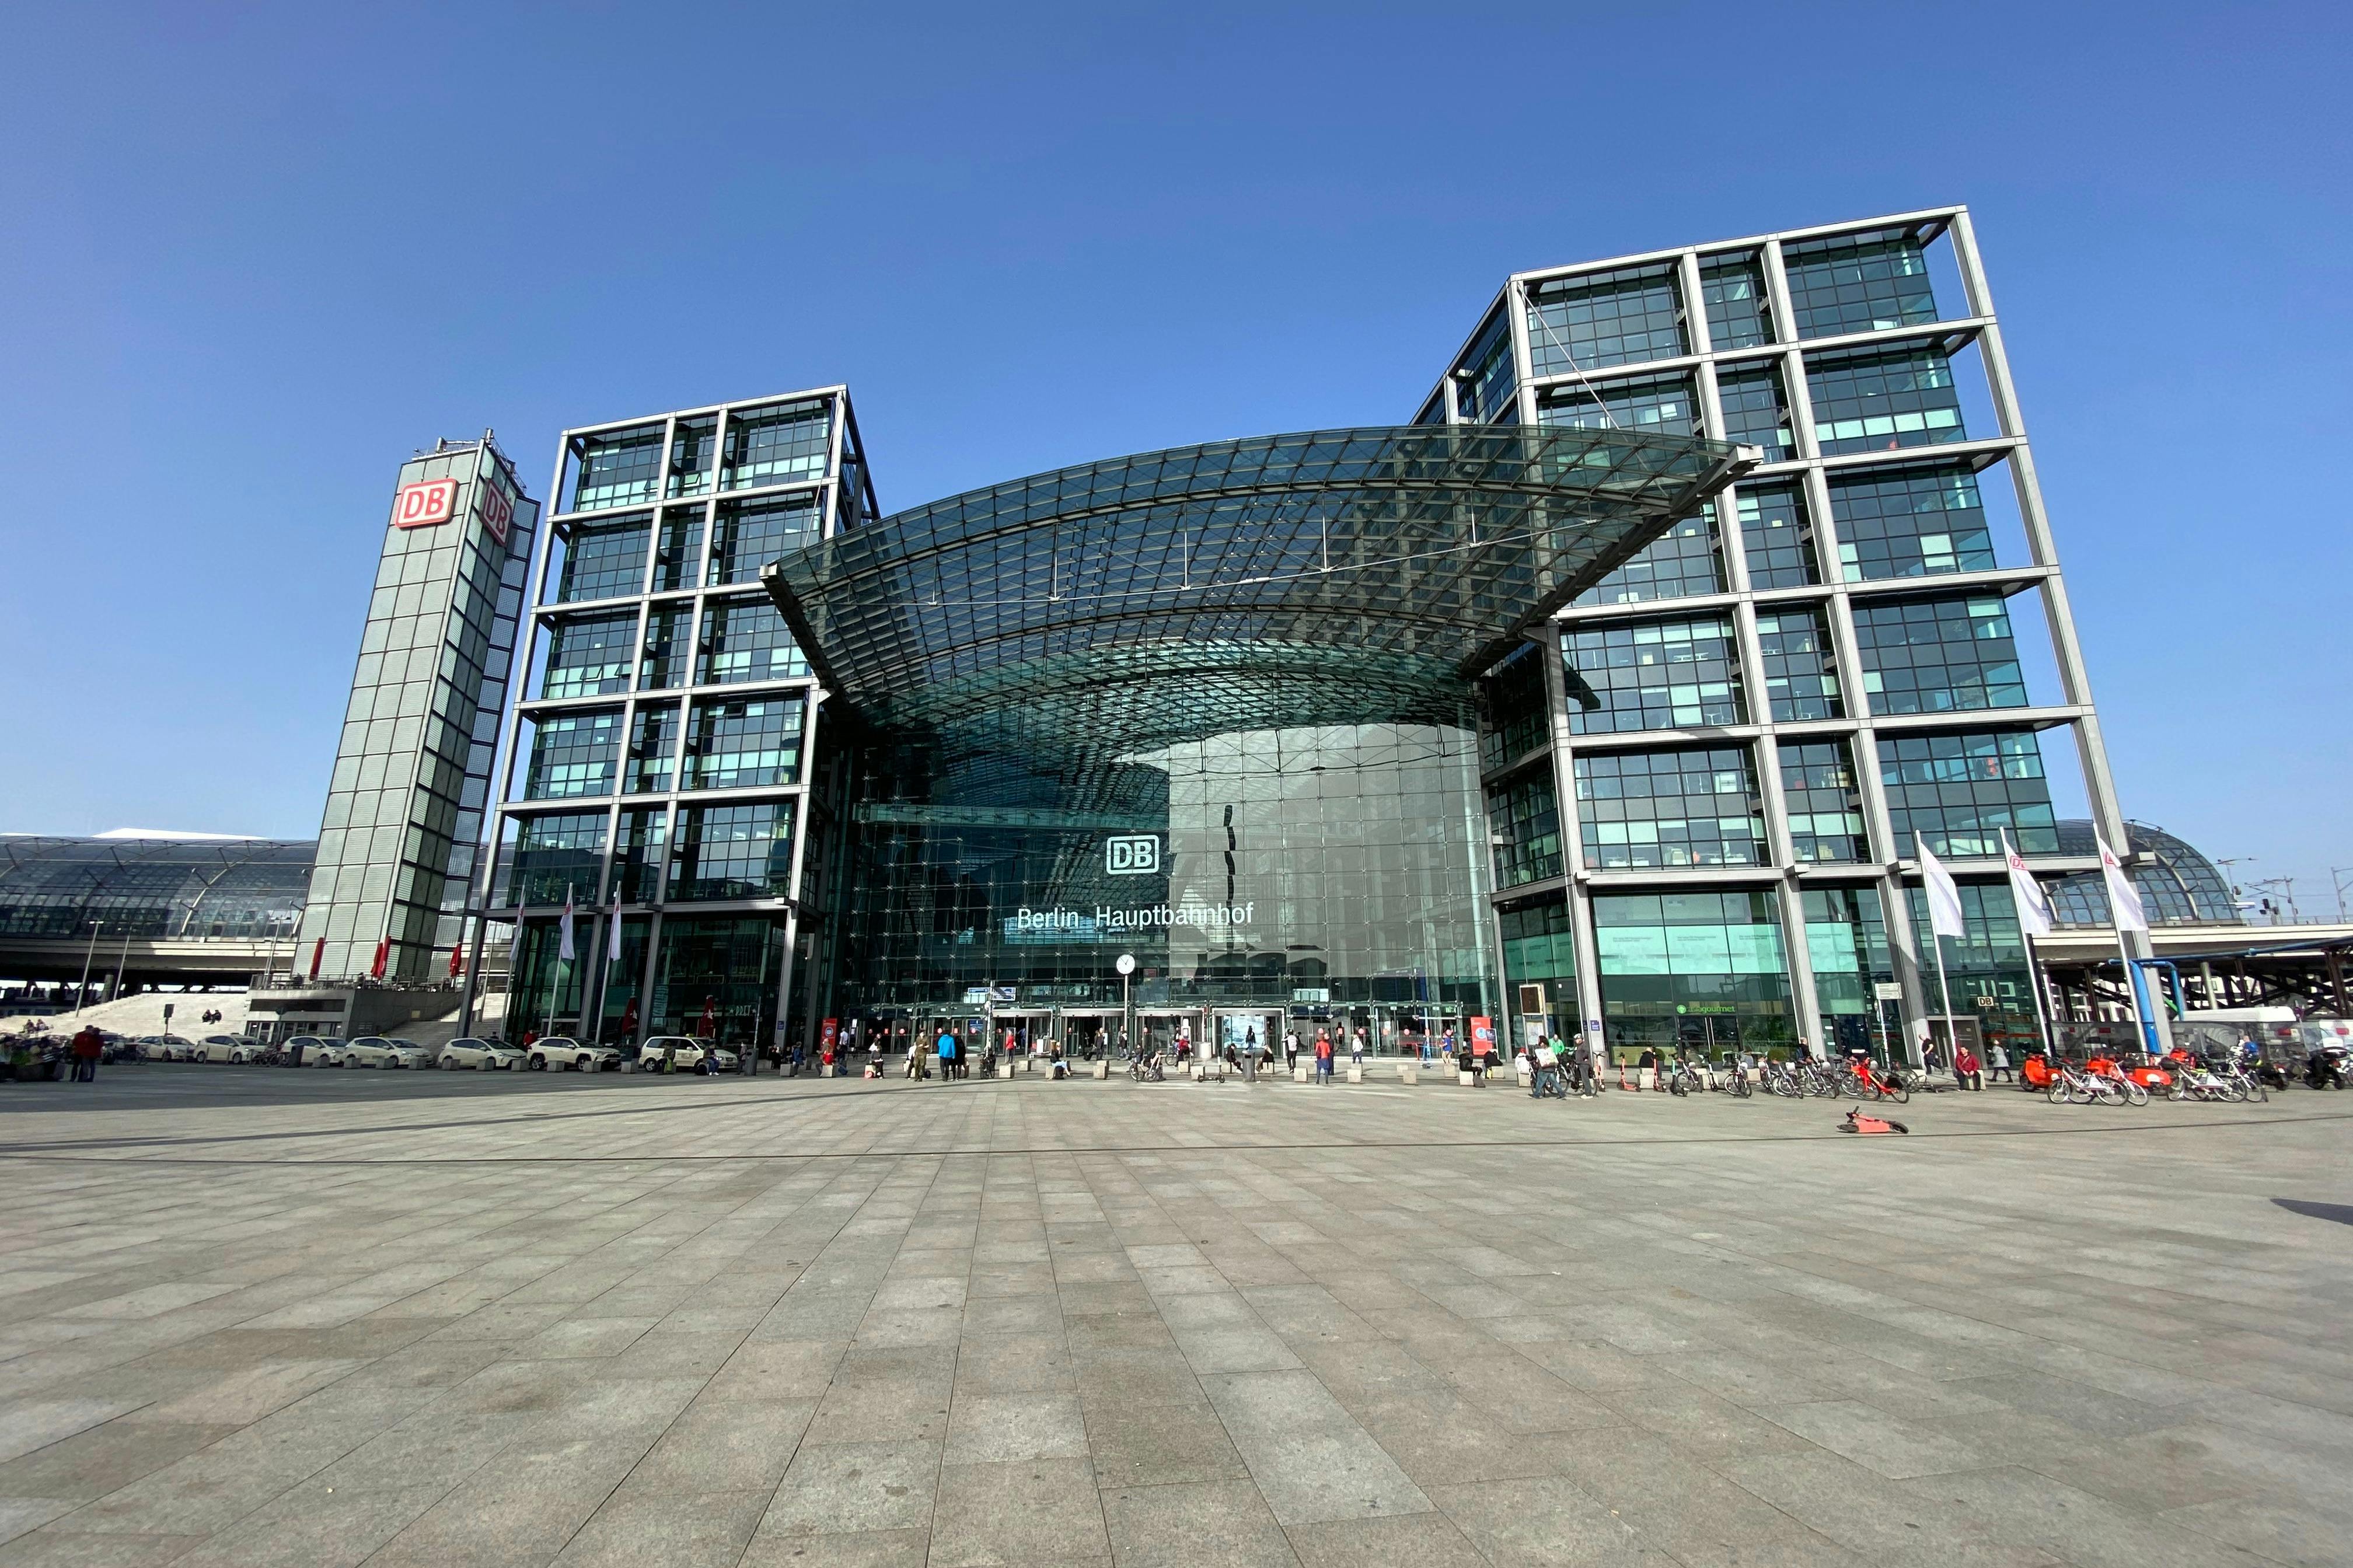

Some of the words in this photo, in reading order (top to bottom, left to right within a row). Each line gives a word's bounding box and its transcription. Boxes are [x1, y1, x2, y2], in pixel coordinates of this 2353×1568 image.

[403, 487, 445, 519] DB
[486, 489, 508, 533] DB
[1113, 841, 1153, 868] DB
[1017, 907, 1079, 929] Berlin
[1095, 902, 1254, 931] Hauptbahnhof
